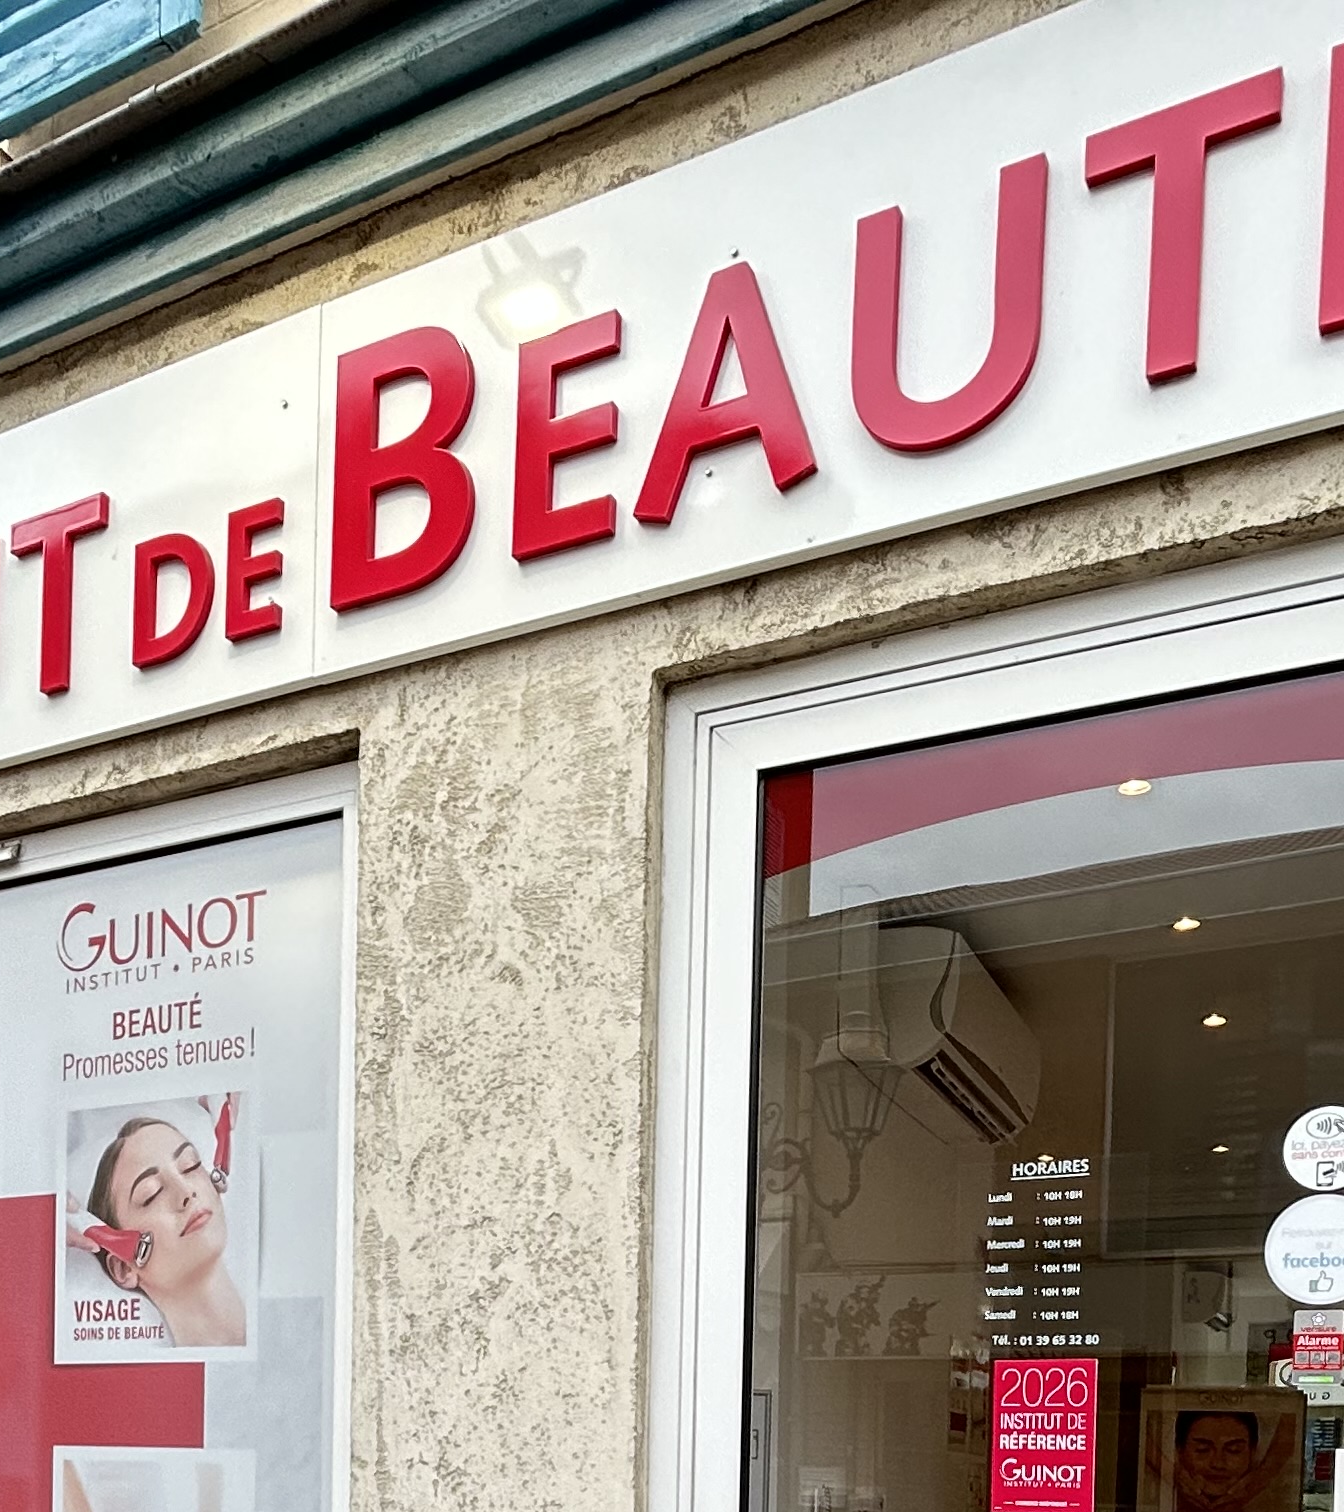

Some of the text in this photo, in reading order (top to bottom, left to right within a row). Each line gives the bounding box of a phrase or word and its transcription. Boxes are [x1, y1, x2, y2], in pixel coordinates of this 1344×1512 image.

[133, 499, 285, 670] DE
[56, 889, 268, 973] GUINOT
[65, 947, 256, 995] INSTITUT PARIS
[112, 992, 203, 1041] BEAUTÉ
[61, 1045, 169, 1082] Promesses
[1011, 1158, 1090, 1177] HORAIRES
[73, 1297, 142, 1323] VISAGE
[73, 1321, 165, 1342] SOINS DE BEAUTÉ
[1019, 1336, 1033, 1346] 01
[1036, 1336, 1050, 1346] 39
[1052, 1335, 1066, 1345] 65
[1068, 1335, 1083, 1345] 32
[1085, 1334, 1100, 1345] 80
[1296, 1335, 1339, 1346] Alarme
[1000, 1367, 1089, 1408] 2026
[1000, 1412, 1087, 1430] INSTITUT DE
[999, 1431, 1087, 1451] RÉFÉRENCE
[999, 1457, 1087, 1482] GUINOT
